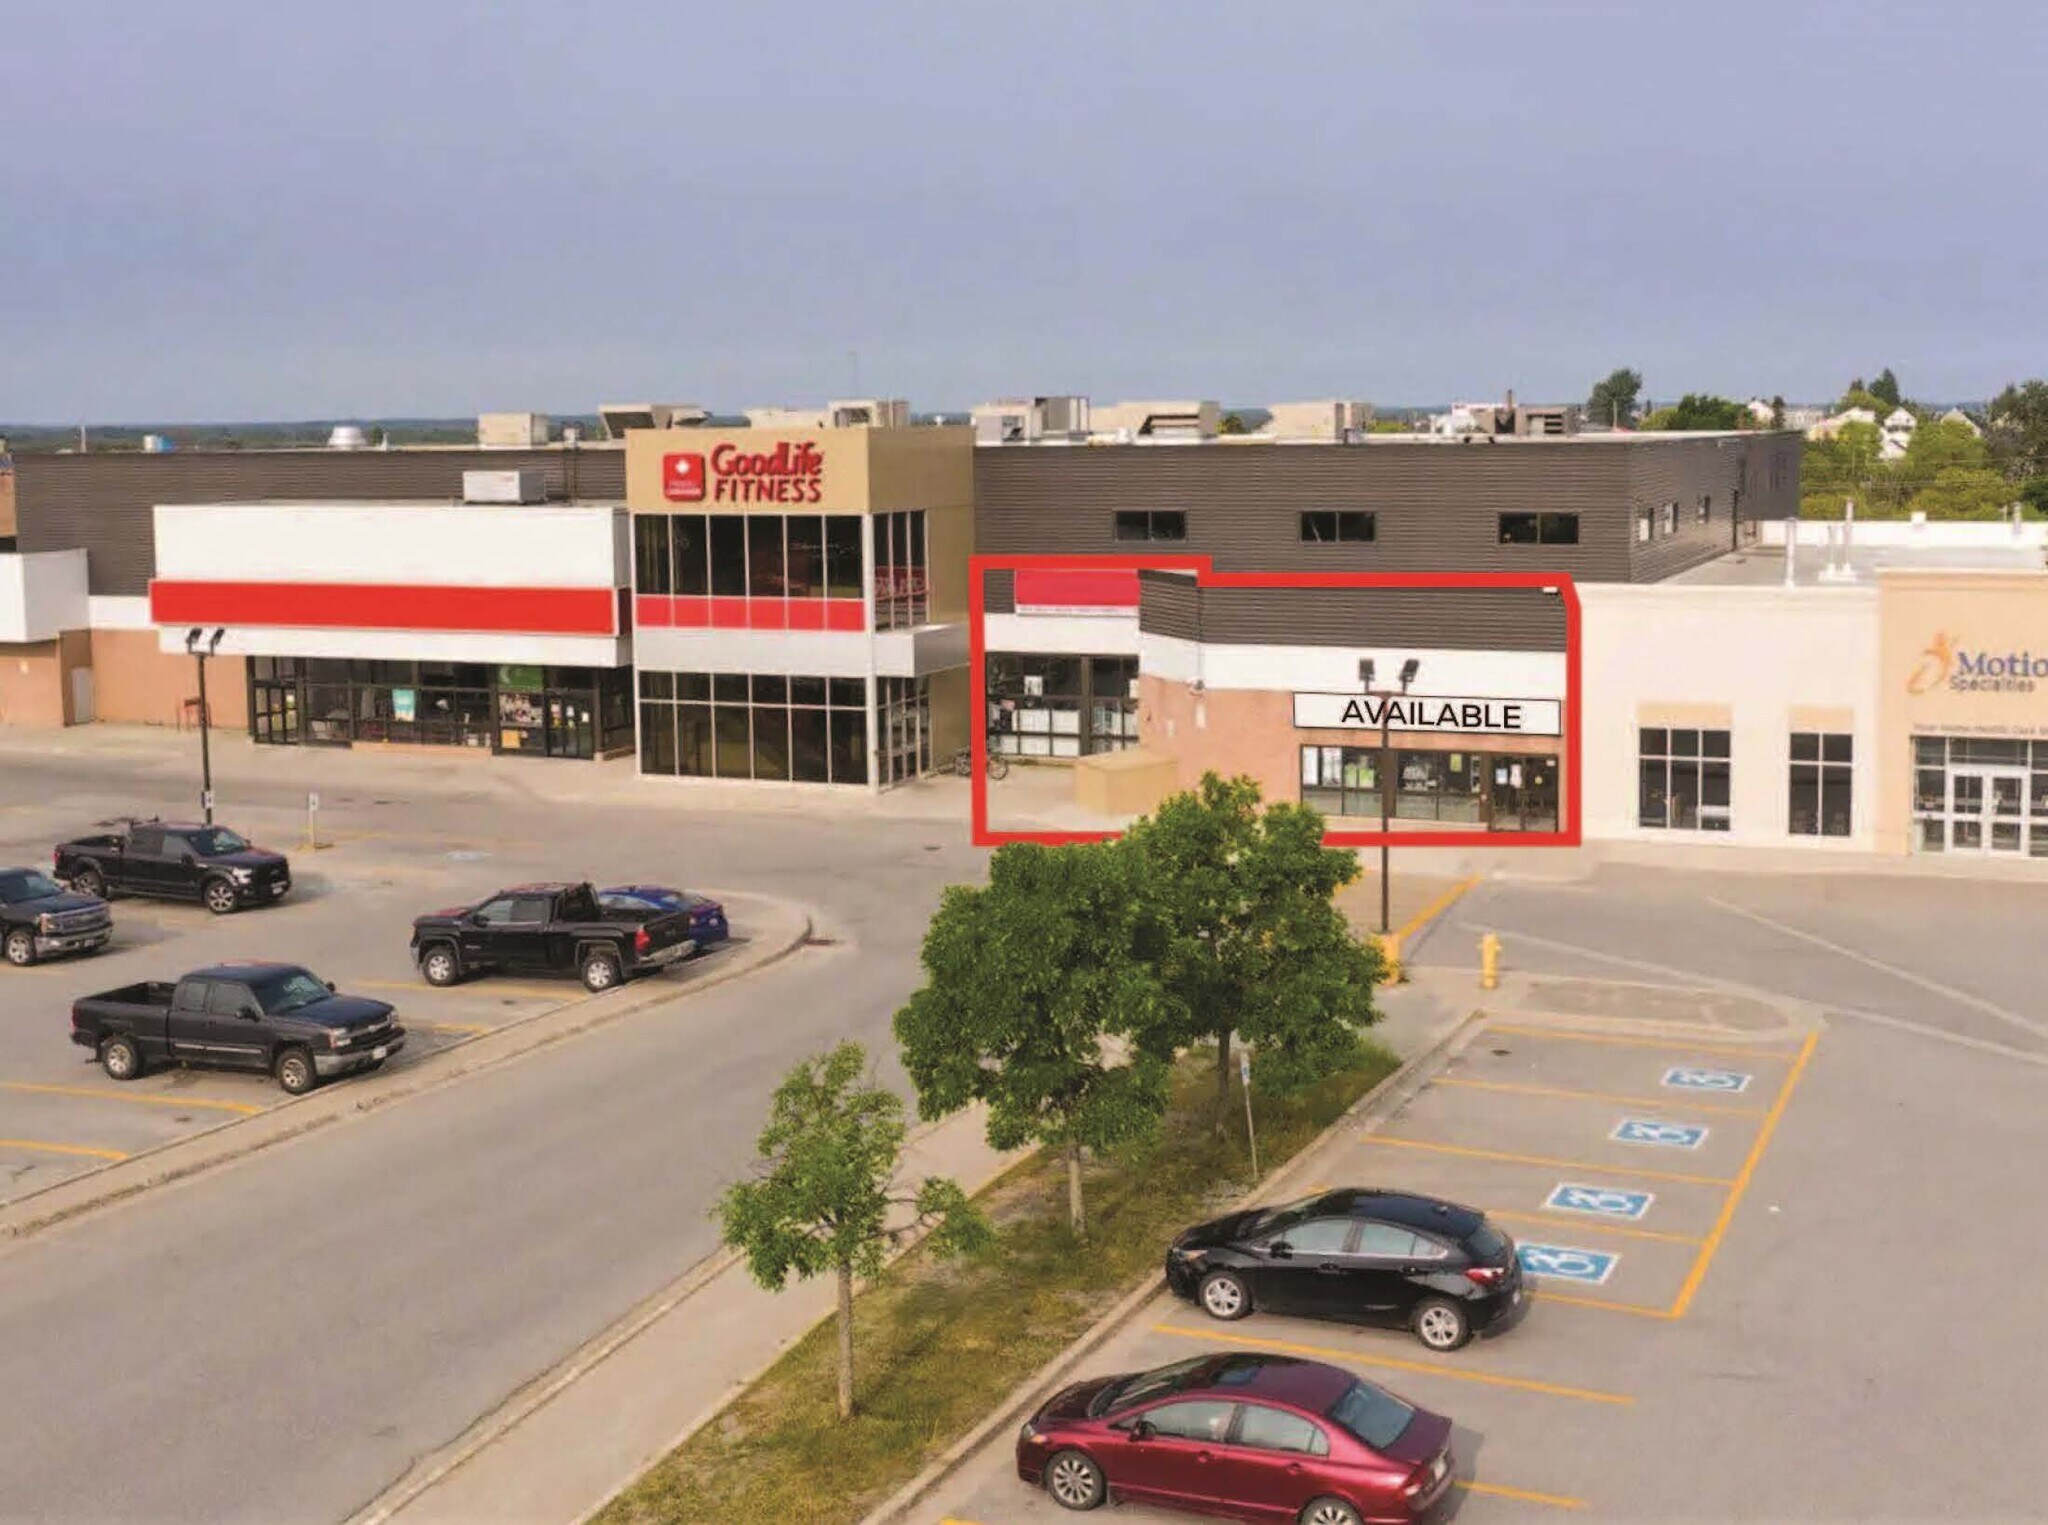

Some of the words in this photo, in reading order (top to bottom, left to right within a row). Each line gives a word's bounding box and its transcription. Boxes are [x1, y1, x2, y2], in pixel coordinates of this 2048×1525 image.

[711, 441, 823, 476] GoodLife
[714, 478, 822, 502] FITNESS
[1949, 674, 2035, 692] Specialties
[1341, 699, 1521, 729] AVAILABLE
